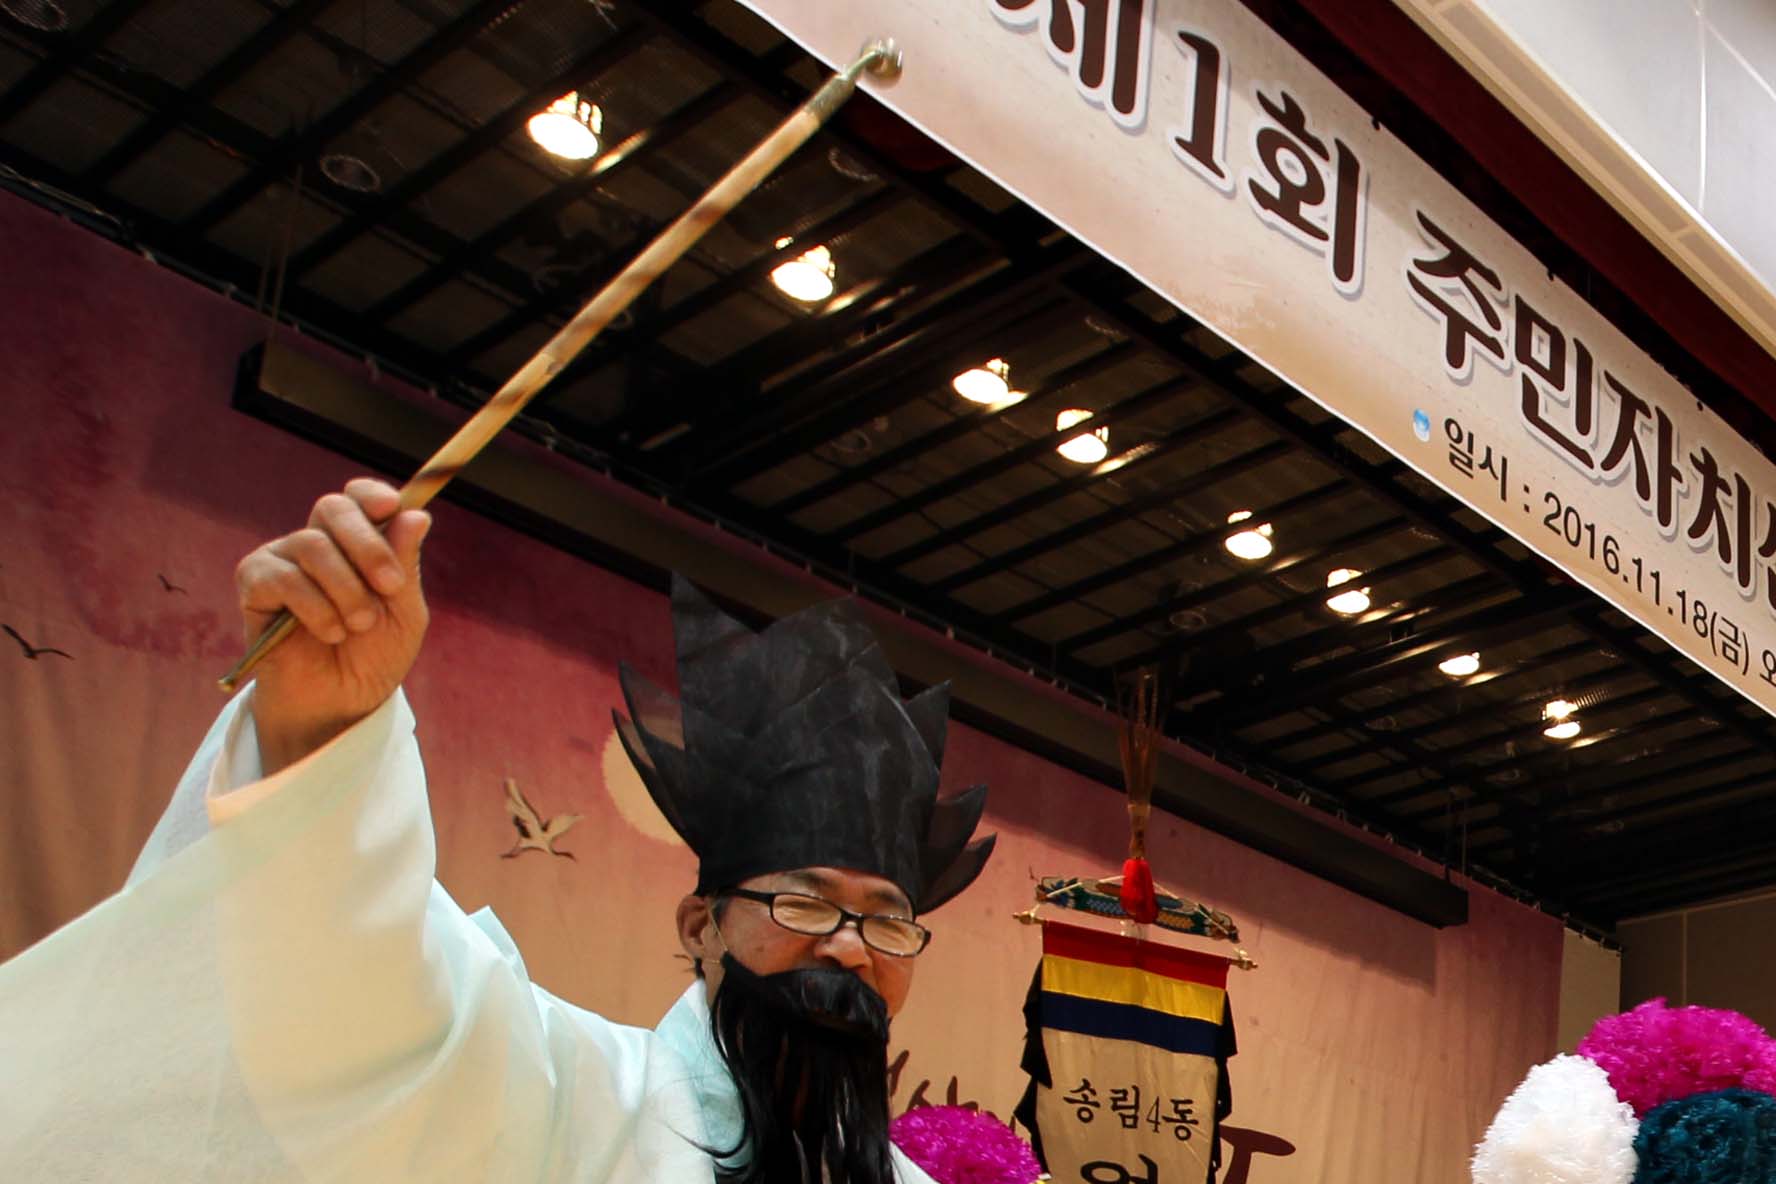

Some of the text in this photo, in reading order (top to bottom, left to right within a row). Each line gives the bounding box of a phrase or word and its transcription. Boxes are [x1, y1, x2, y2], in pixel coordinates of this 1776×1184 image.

[1444, 417, 1508, 502] 일시
[1542, 491, 1750, 676] 2016.11.18(금)
[1062, 1078, 1199, 1142] 송림4동
